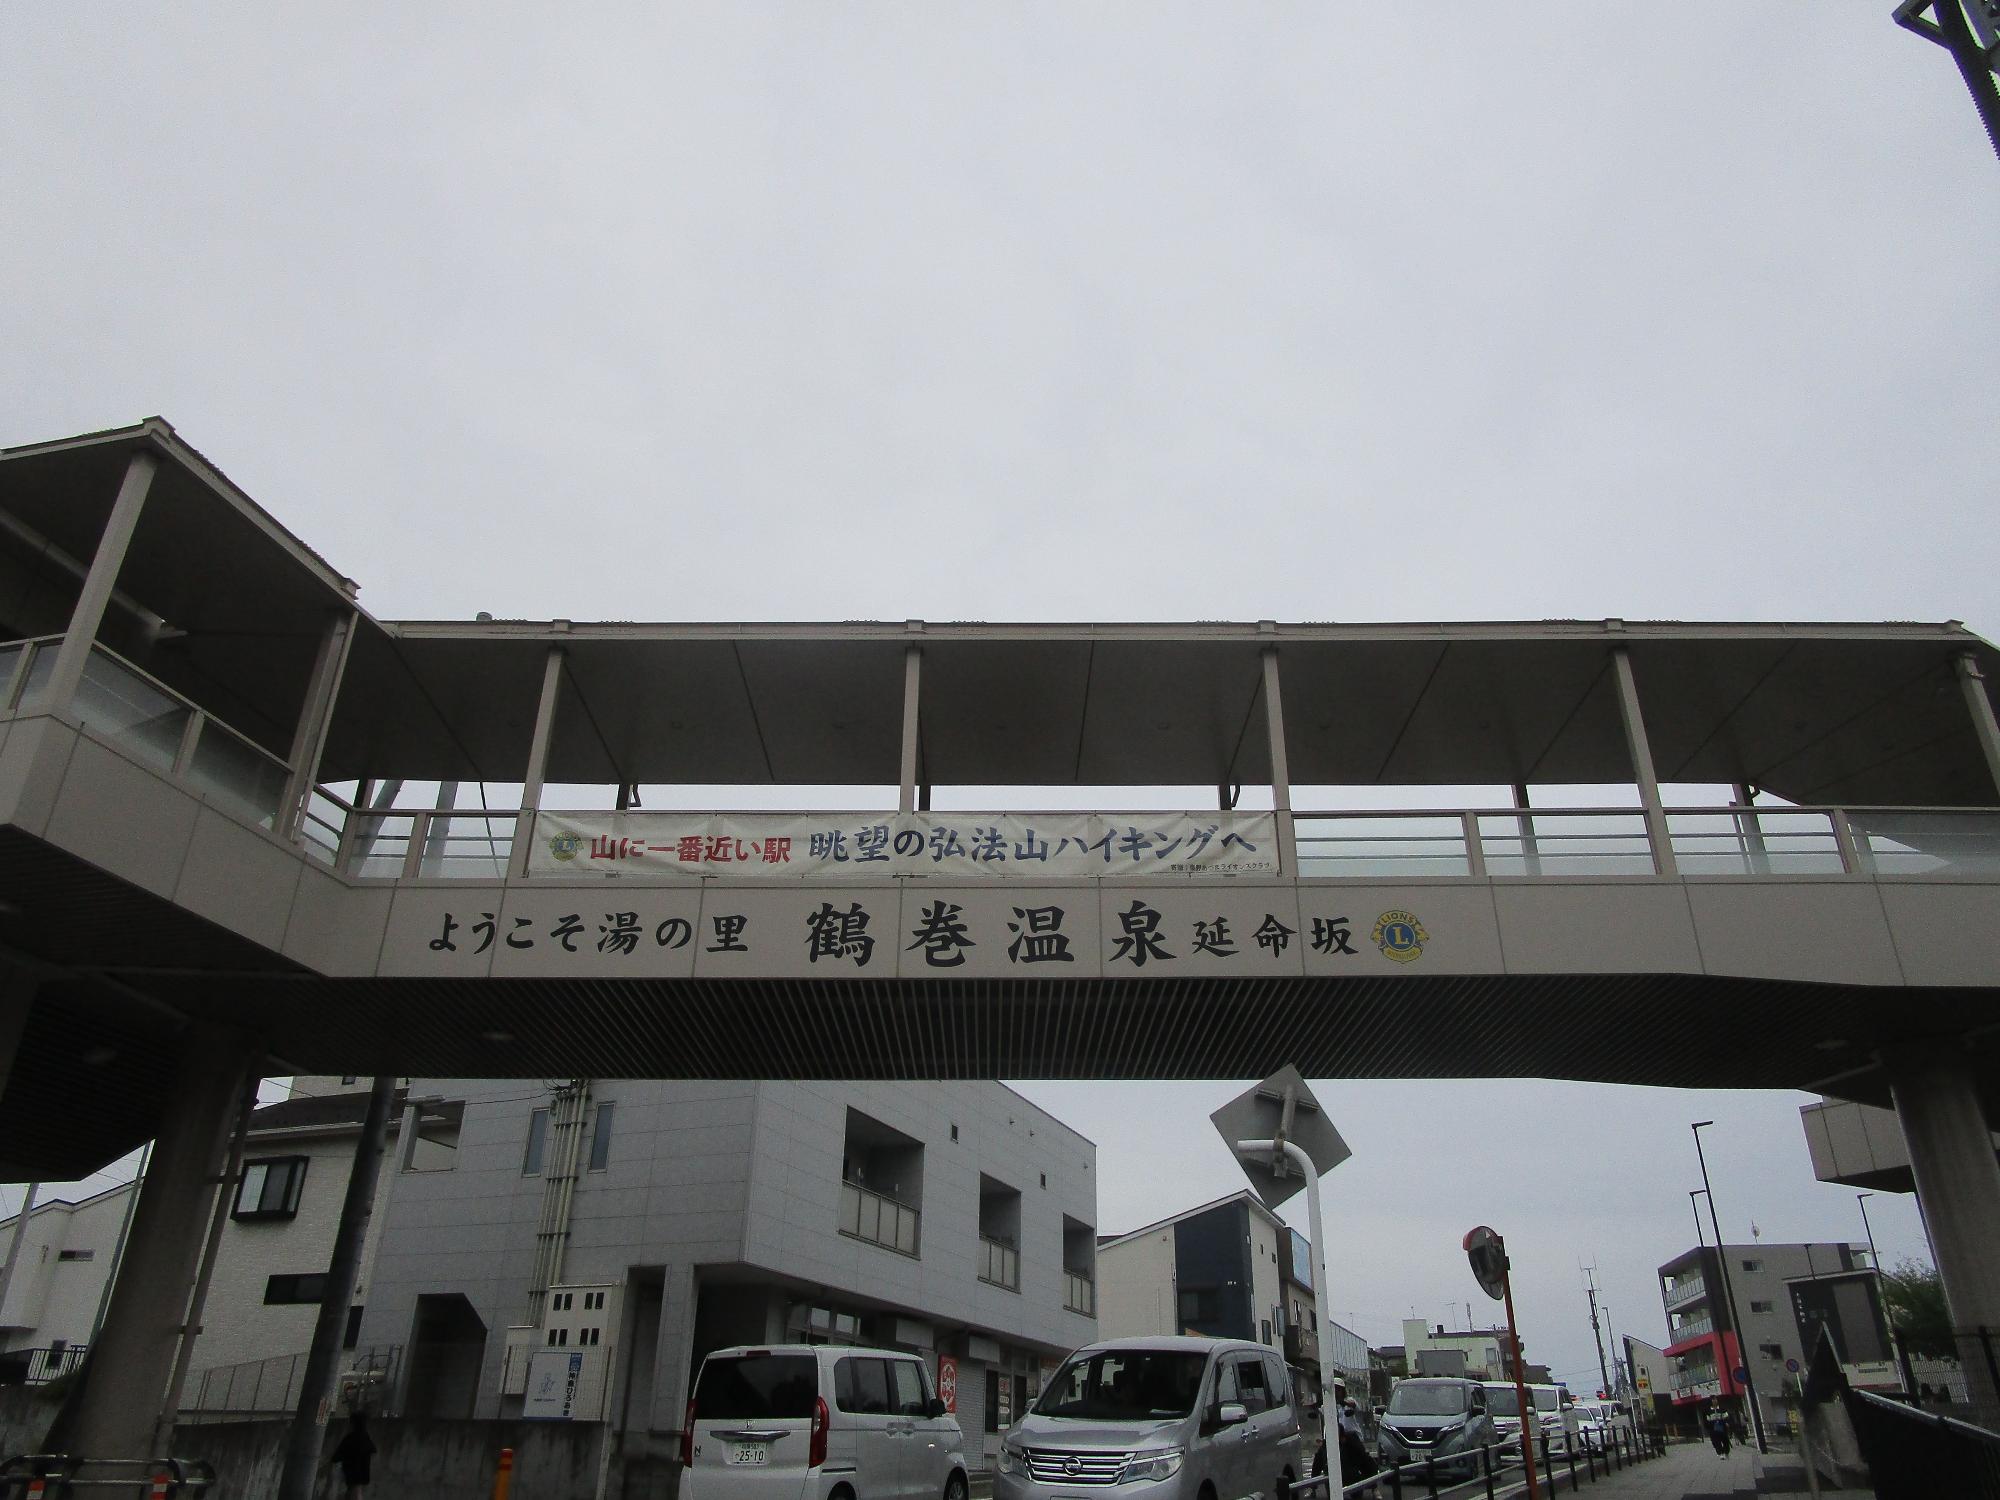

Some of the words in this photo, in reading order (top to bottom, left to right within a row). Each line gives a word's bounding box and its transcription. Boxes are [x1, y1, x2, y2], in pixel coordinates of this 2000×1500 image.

[590, 834, 791, 863] 山に一番近い駅
[809, 825, 1256, 863] 眺望の弘法山ハイキングへ
[1381, 912, 1415, 923] LIONS
[429, 911, 749, 955] ようこそ湯の里
[804, 900, 1177, 967] 鶴巻温泉
[1192, 913, 1359, 958] 延命坂
[1393, 926, 1409, 945] L
